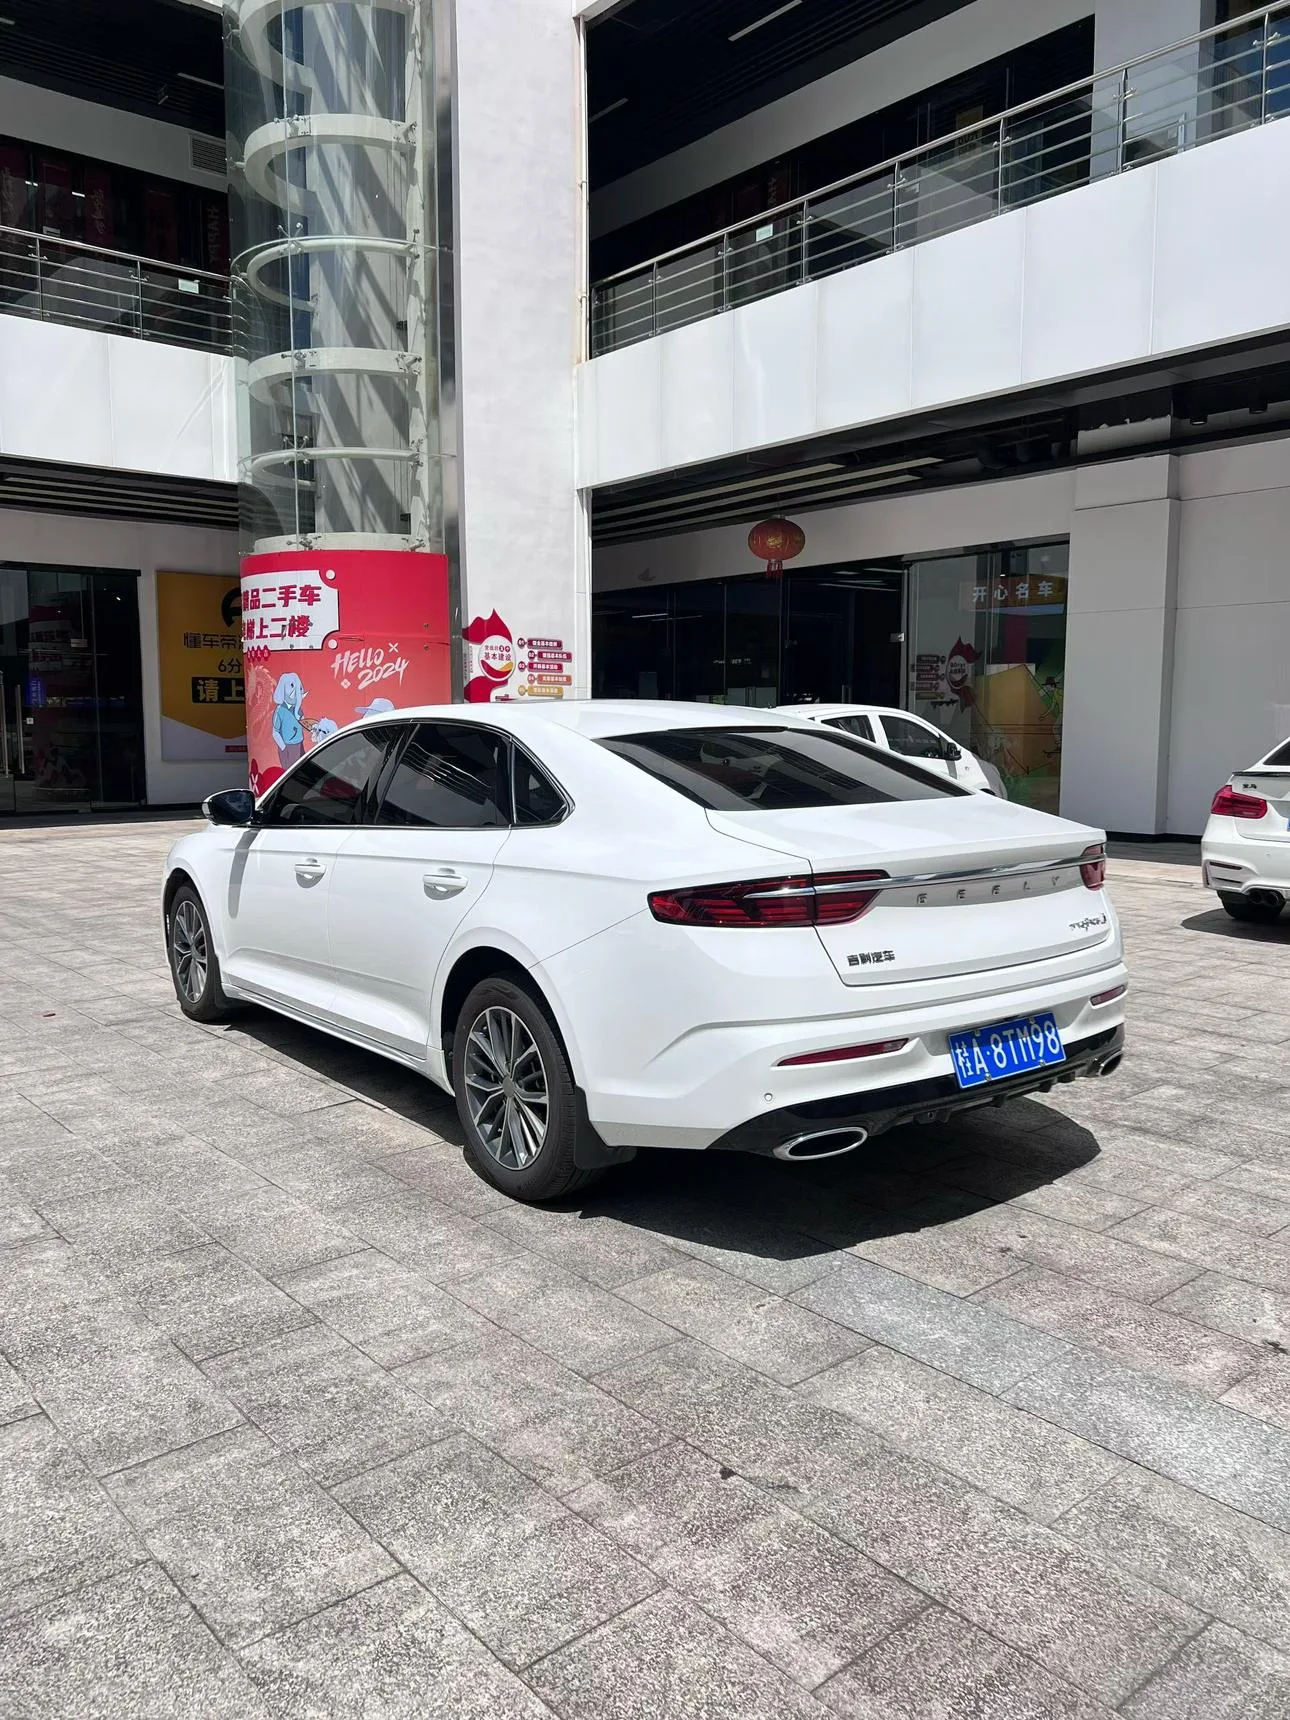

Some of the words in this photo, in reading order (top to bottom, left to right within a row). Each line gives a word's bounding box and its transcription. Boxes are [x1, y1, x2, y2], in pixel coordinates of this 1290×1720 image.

[971, 580, 1054, 603] 开心名车
[331, 647, 385, 680] HELLO
[484, 652, 512, 661] 基本建设
[357, 656, 410, 690] 2024
[916, 875, 1060, 905] GEELY
